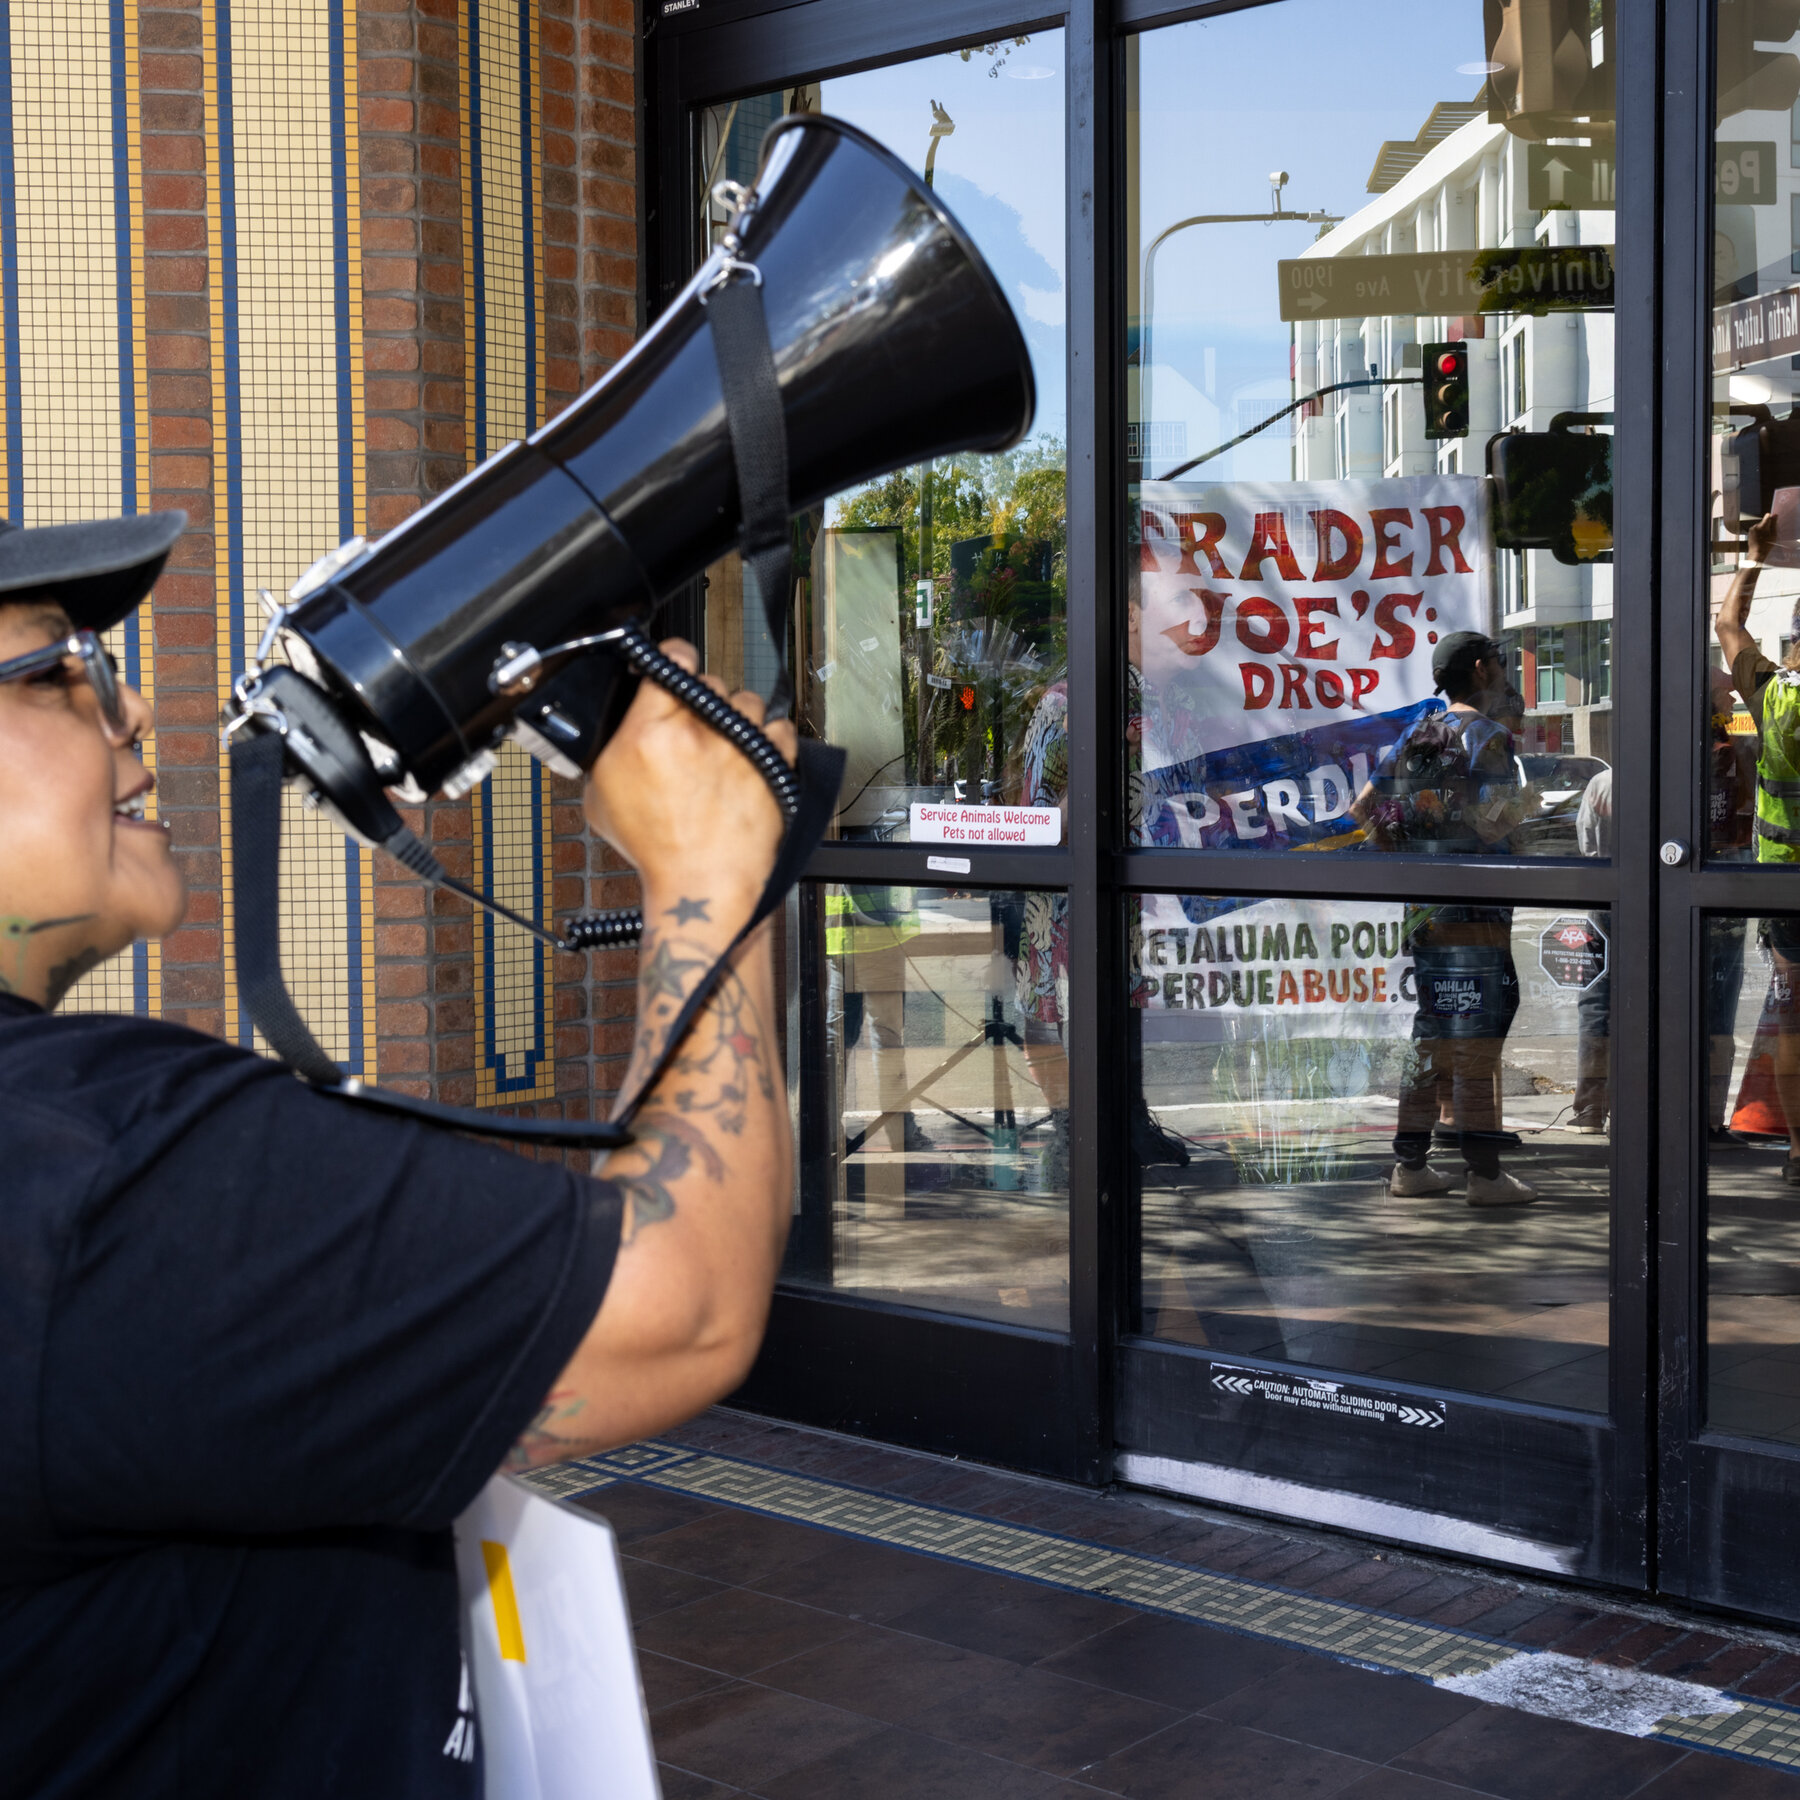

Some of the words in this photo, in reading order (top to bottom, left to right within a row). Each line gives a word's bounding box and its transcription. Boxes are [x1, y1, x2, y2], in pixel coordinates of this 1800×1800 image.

[663, 0, 695, 13] STANLEY
[1160, 588, 1438, 661] JOE'S:
[1239, 662, 1380, 711] DROP
[920, 808, 958, 822] Service
[961, 809, 1000, 824] Animals
[1004, 811, 1050, 825] Welcome
[943, 826, 965, 840] Pets
[968, 828, 985, 840] not
[988, 828, 1026, 842] allowed
[1559, 929, 1587, 945] AFA
[1434, 980, 1476, 993] DAHLIA
[1253, 1379, 1290, 1395] CAUTION:
[1292, 1387, 1339, 1403] AUTOMATIC
[1340, 1394, 1373, 1410] SLIDING
[1374, 1400, 1398, 1413] DOOR
[1265, 1390, 1282, 1402] Door
[1283, 1395, 1299, 1406] may
[1300, 1396, 1321, 1409] close
[1323, 1401, 1352, 1415] without
[1352, 1408, 1385, 1422] warning
